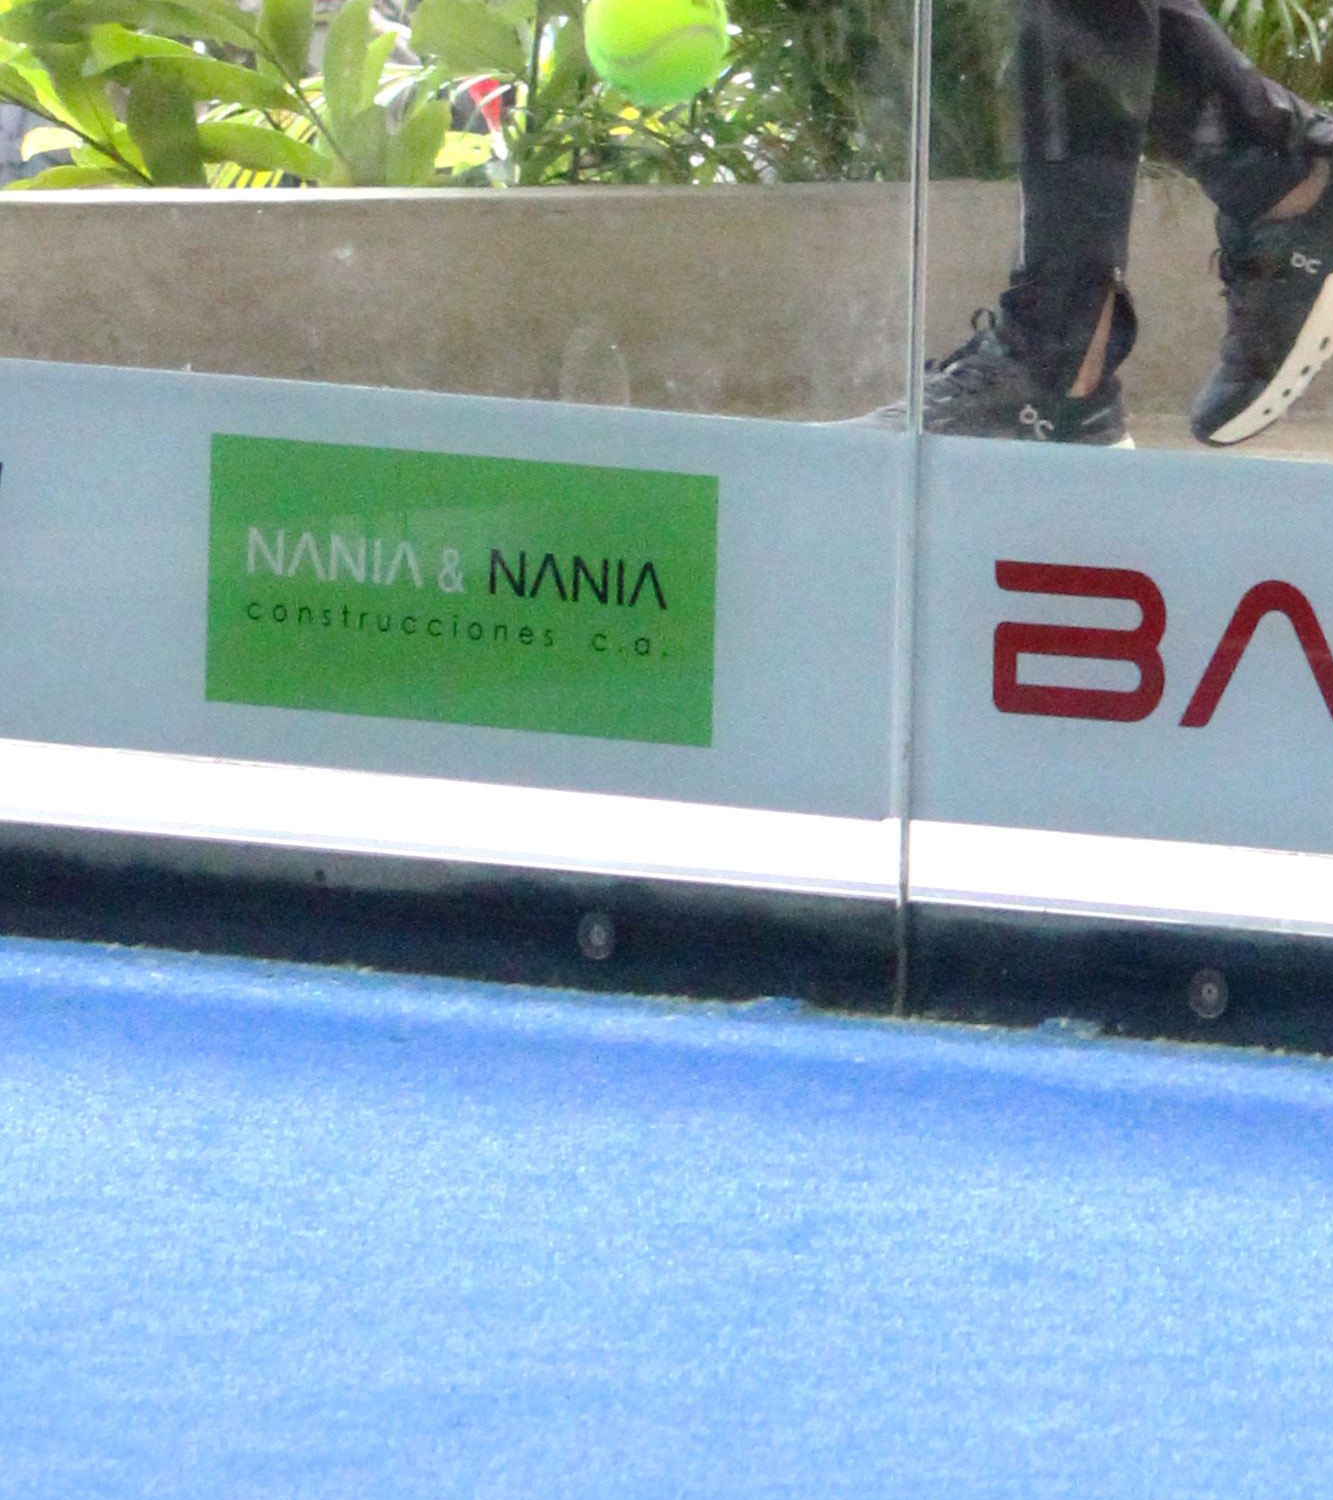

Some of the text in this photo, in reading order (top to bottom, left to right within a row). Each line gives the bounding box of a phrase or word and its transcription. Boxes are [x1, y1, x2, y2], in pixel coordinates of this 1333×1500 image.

[245, 526, 667, 610] NANIA & NANIA
[246, 600, 669, 657] construcciones c.a.
